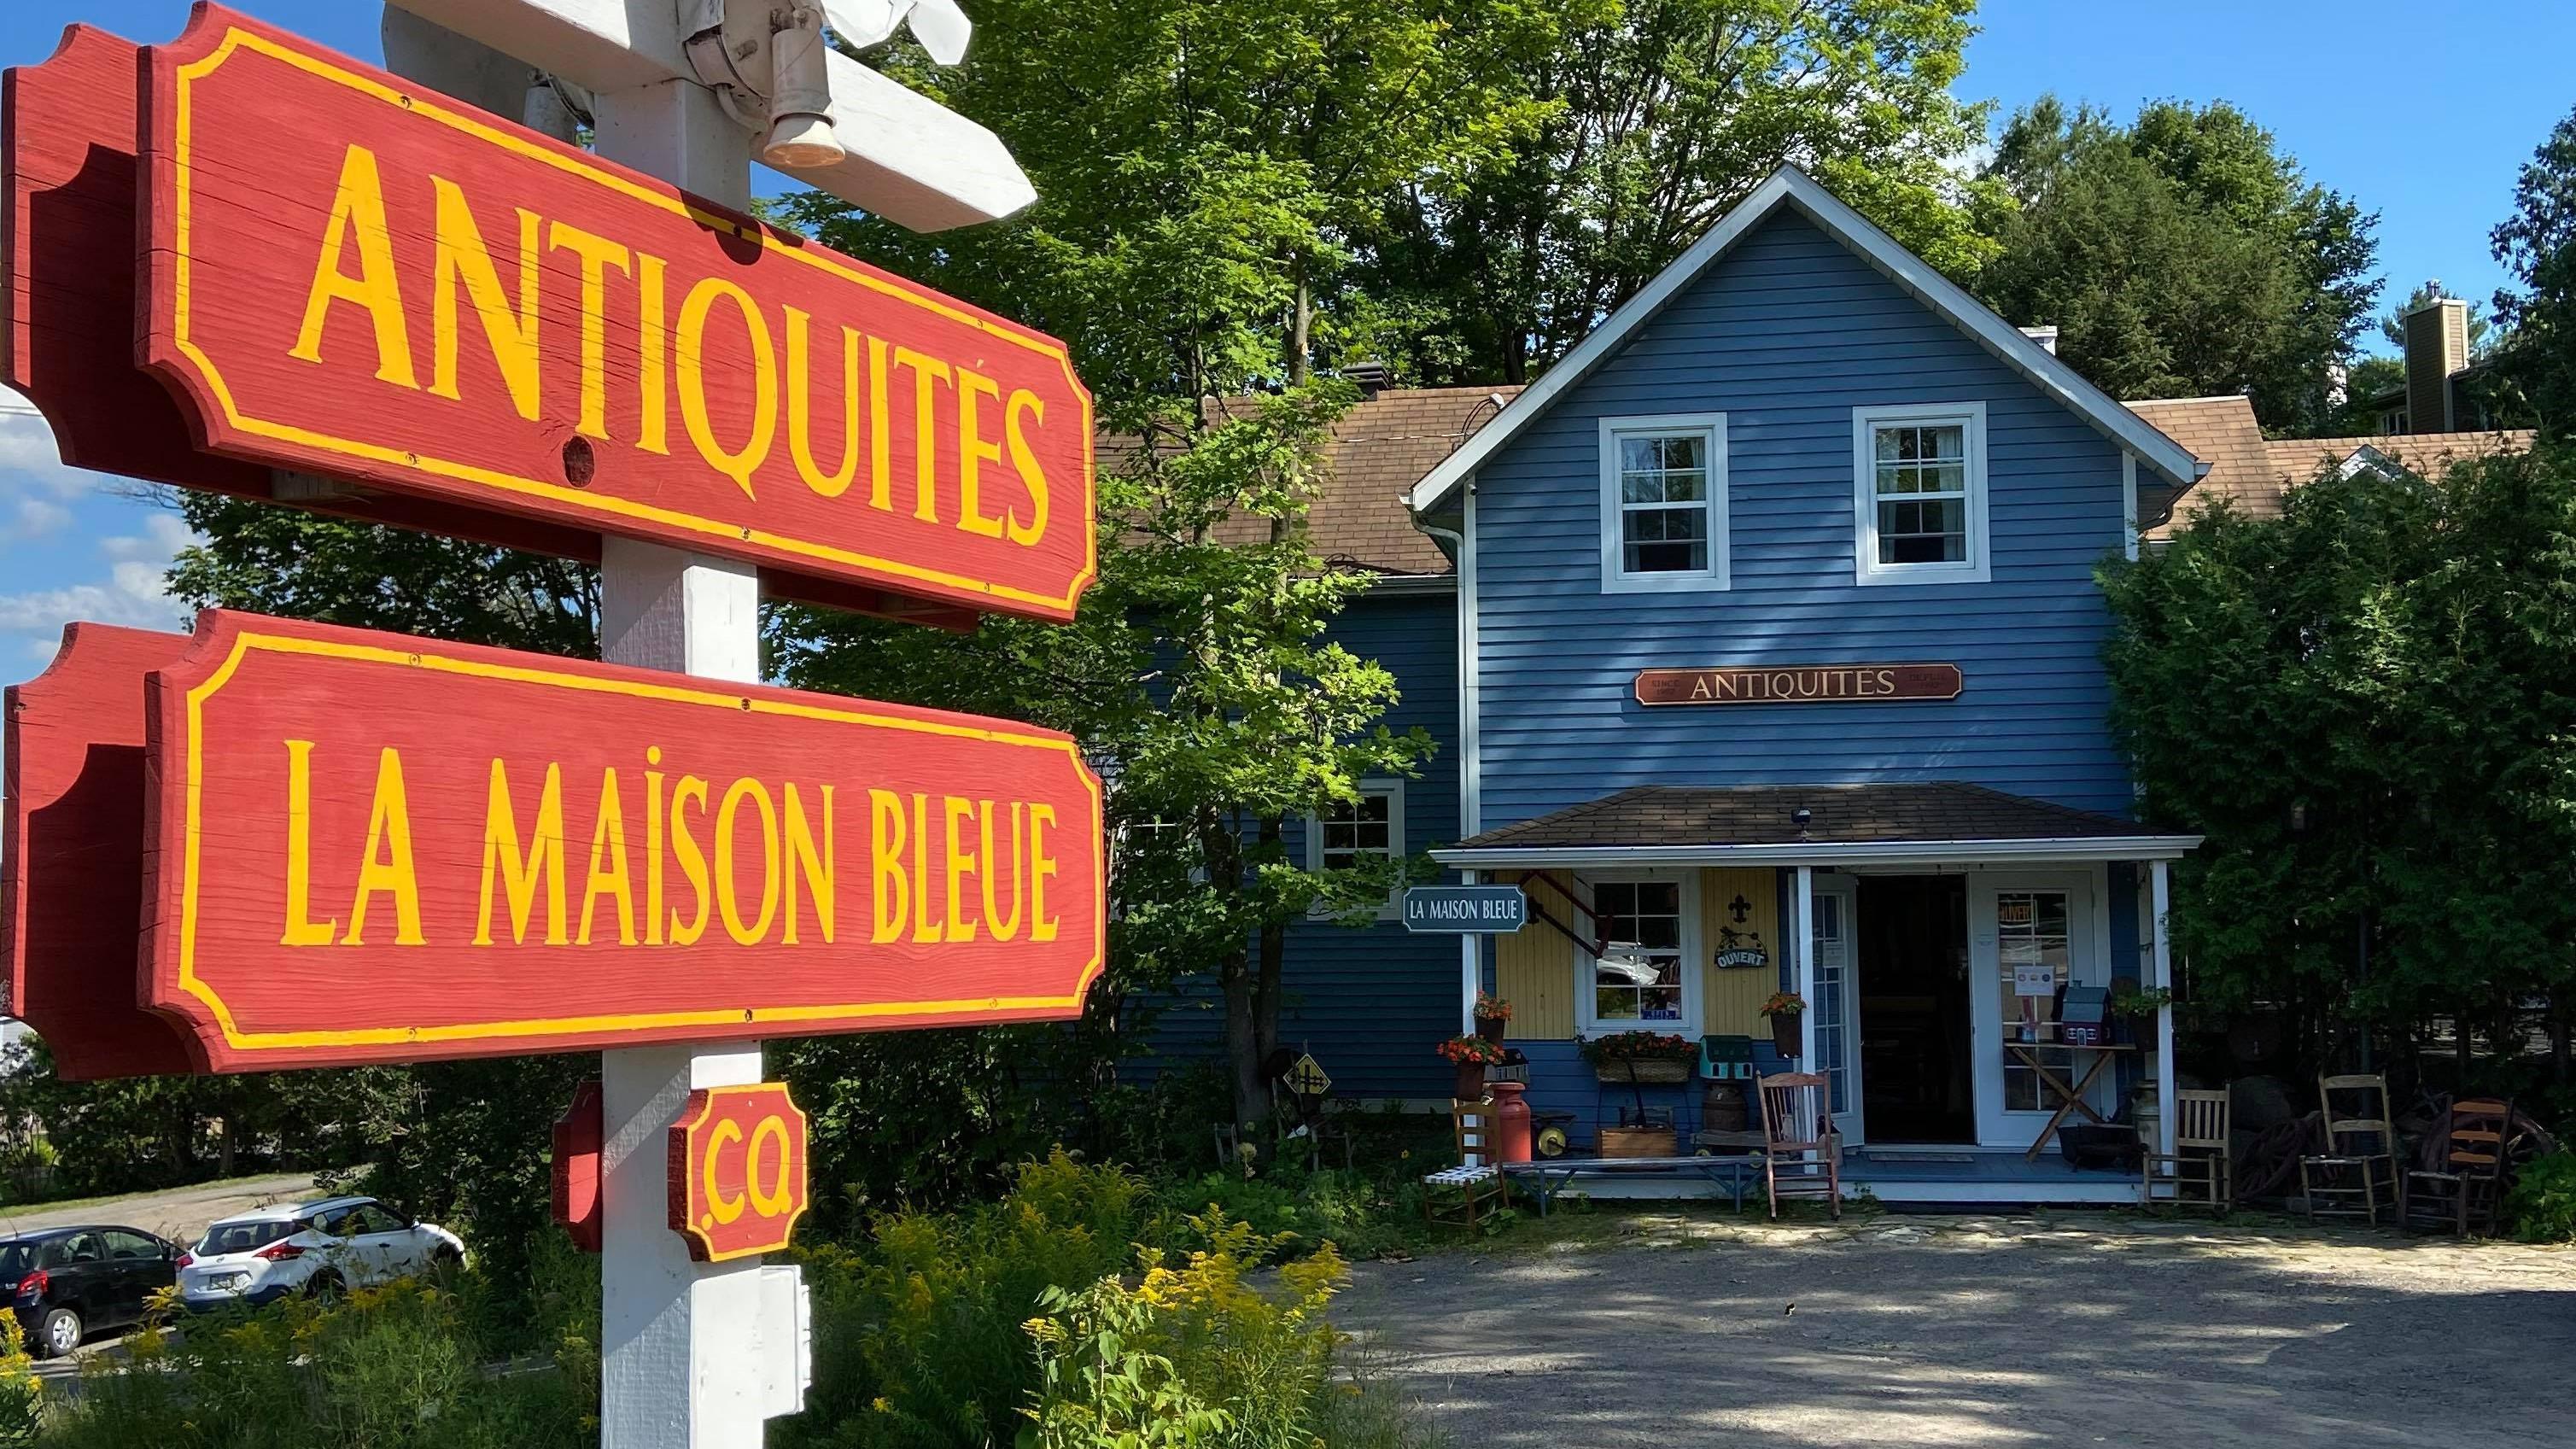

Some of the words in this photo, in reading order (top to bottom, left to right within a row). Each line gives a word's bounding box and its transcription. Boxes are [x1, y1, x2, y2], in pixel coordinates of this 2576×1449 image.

[289, 143, 1049, 547] ANTIQUITÉS
[1690, 668, 1895, 699] ANTIQUITÉS
[280, 739, 428, 947] LA
[867, 788, 1060, 944] BLEUE
[1410, 900, 1424, 919] LA
[1429, 899, 1478, 920] MAISON
[1482, 899, 1517, 919] BLEUE
[1717, 951, 1765, 967] OUVERT
